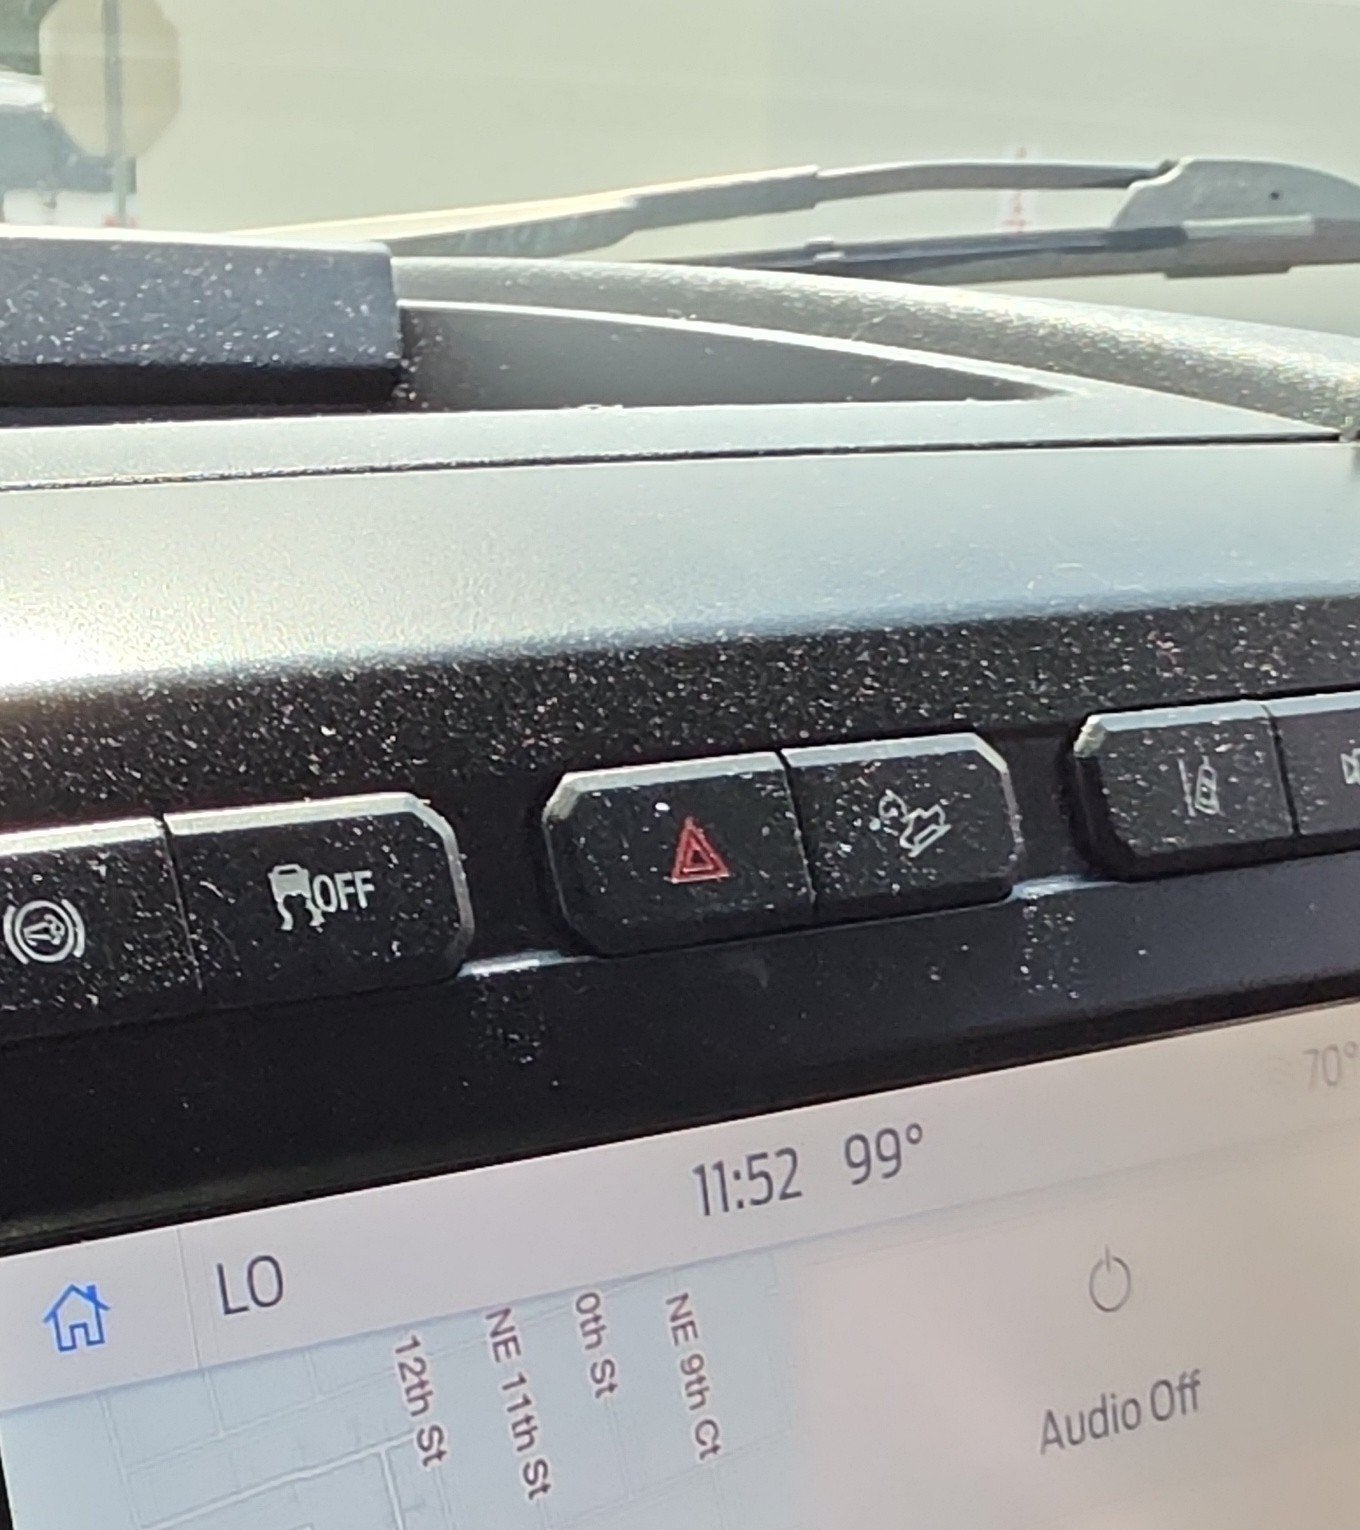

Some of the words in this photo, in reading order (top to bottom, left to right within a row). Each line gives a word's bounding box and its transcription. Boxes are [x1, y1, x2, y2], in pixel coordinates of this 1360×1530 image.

[313, 870, 375, 913] OFF
[692, 1147, 803, 1216] 11:52
[844, 1122, 924, 1185] 99°
[216, 1255, 285, 1316] LO
[485, 1307, 522, 1363] NE
[575, 1292, 607, 1350] 0th
[666, 1292, 699, 1347] NE
[395, 1336, 434, 1417] 12th
[416, 1424, 448, 1468] St
[590, 1358, 619, 1399] St
[680, 1353, 711, 1411] 9th
[502, 1371, 539, 1452] 11th
[694, 1418, 722, 1461] Ct
[1040, 1394, 1141, 1455] Audio
[1149, 1369, 1202, 1422] Off
[522, 1458, 551, 1501] St
